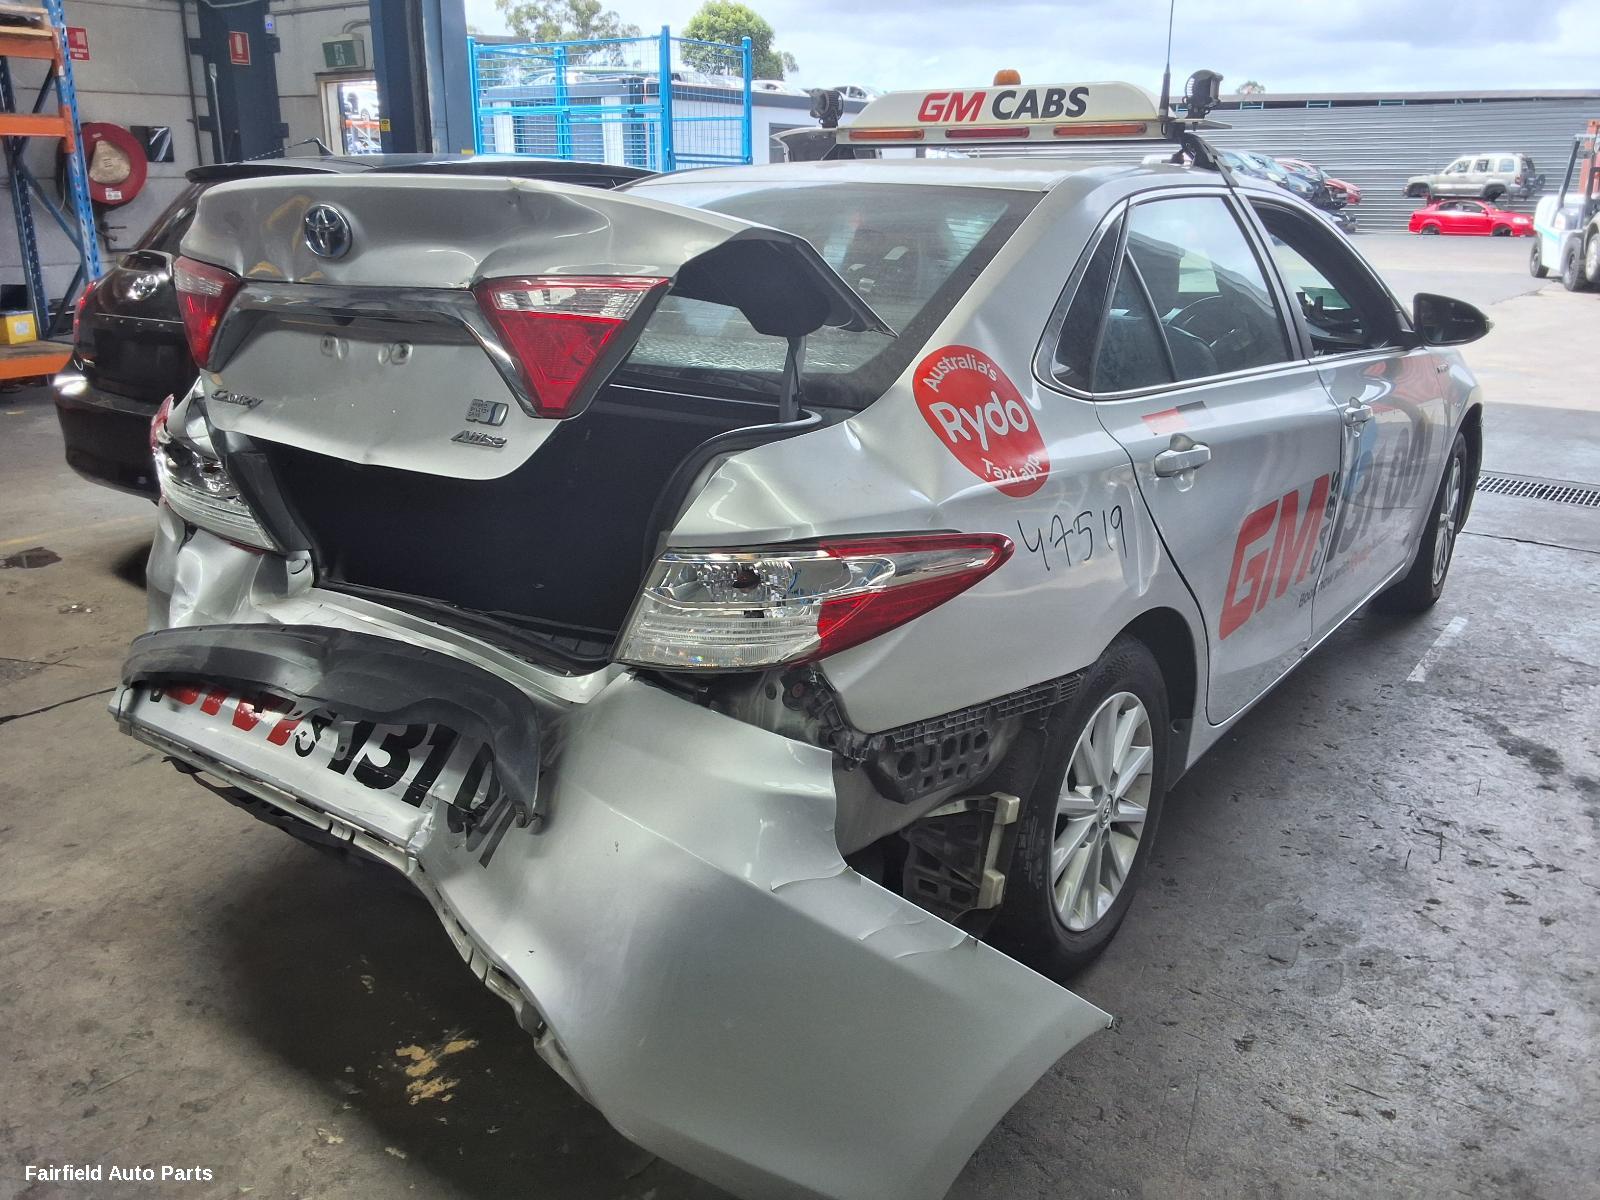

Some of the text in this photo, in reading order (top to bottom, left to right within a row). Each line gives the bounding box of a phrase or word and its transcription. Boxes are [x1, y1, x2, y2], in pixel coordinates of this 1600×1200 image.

[917, 86, 1090, 122] GM CABS
[923, 353, 998, 393] Australia's
[928, 391, 1029, 451] Rydo
[981, 454, 1043, 483] Taxi app
[1017, 505, 1127, 571] 47519
[1219, 473, 1330, 641] GM
